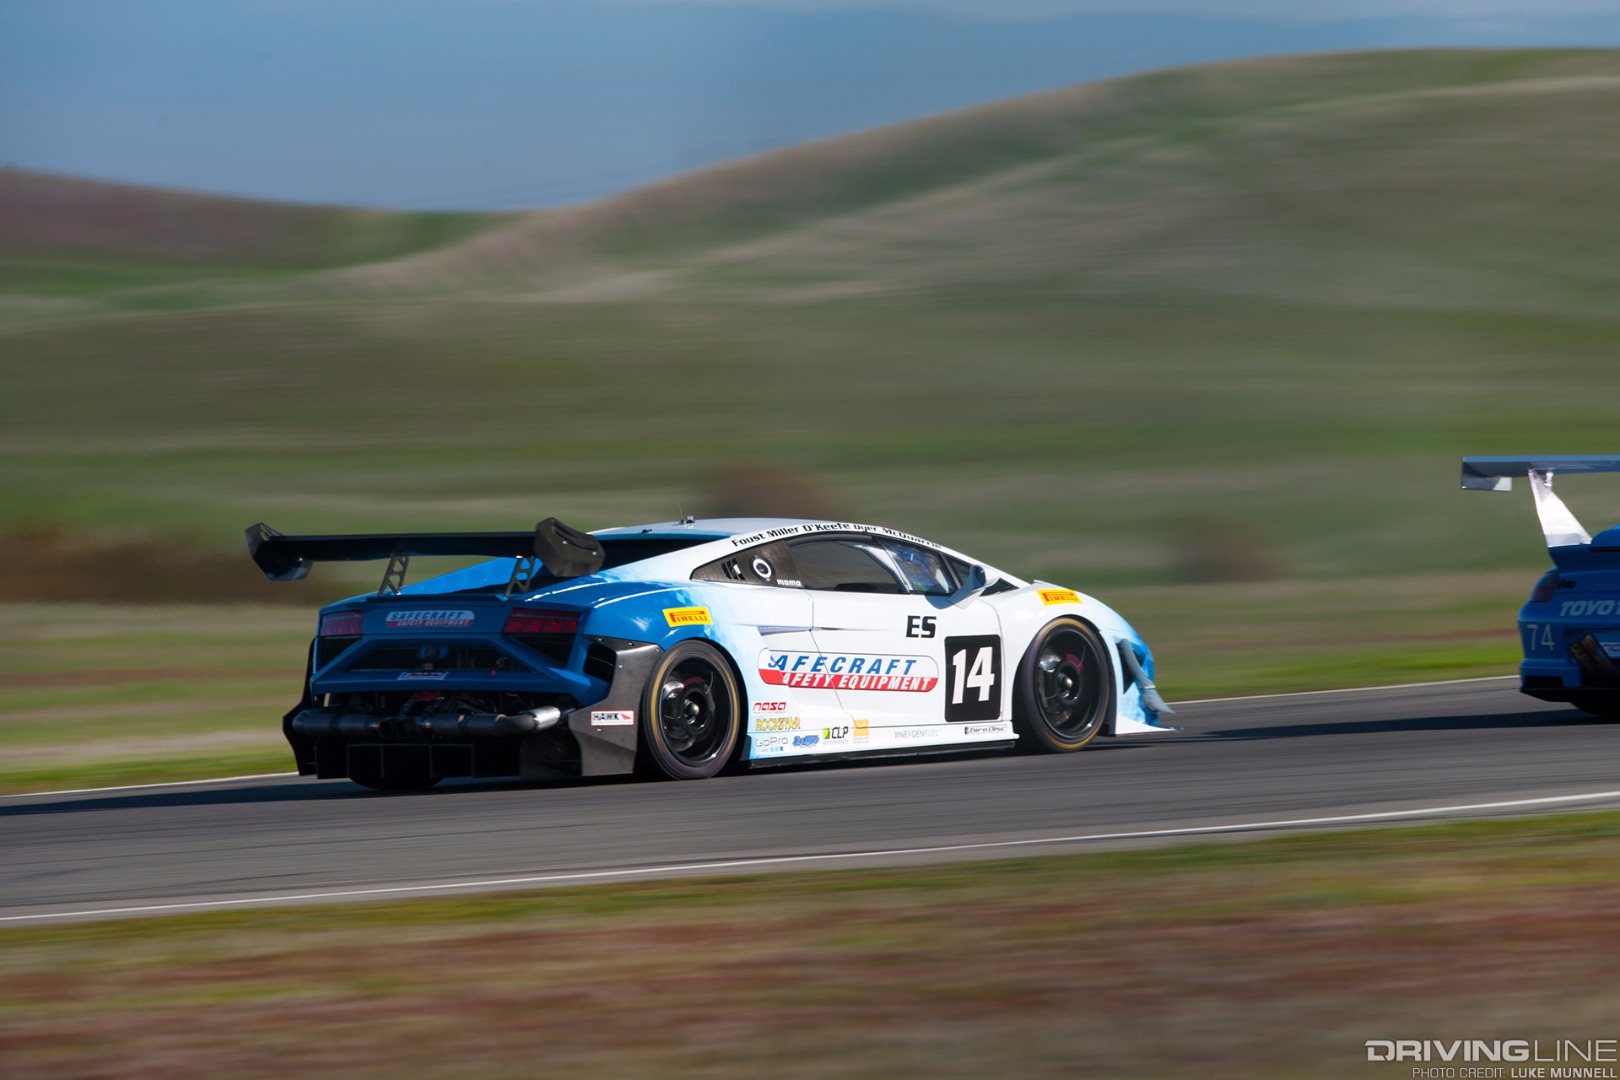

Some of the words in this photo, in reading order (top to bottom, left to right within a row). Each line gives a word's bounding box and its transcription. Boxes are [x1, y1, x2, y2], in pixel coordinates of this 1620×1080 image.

[731, 532, 767, 547] Foust
[766, 525, 799, 539] Miller
[803, 522, 850, 532] O'Keefe
[853, 523, 877, 533] Dyer
[1041, 591, 1078, 603] PIRELLI
[391, 612, 464, 620] SAFECRAFT
[668, 610, 708, 623] PIRELLI
[425, 619, 469, 627] EQUIPMENT
[906, 615, 937, 638] ES
[1526, 624, 1555, 651] 74
[952, 646, 995, 705] 14
[838, 674, 932, 691] EQUIPMENT
[831, 726, 849, 739] CLP
[755, 737, 789, 747] GoPro
